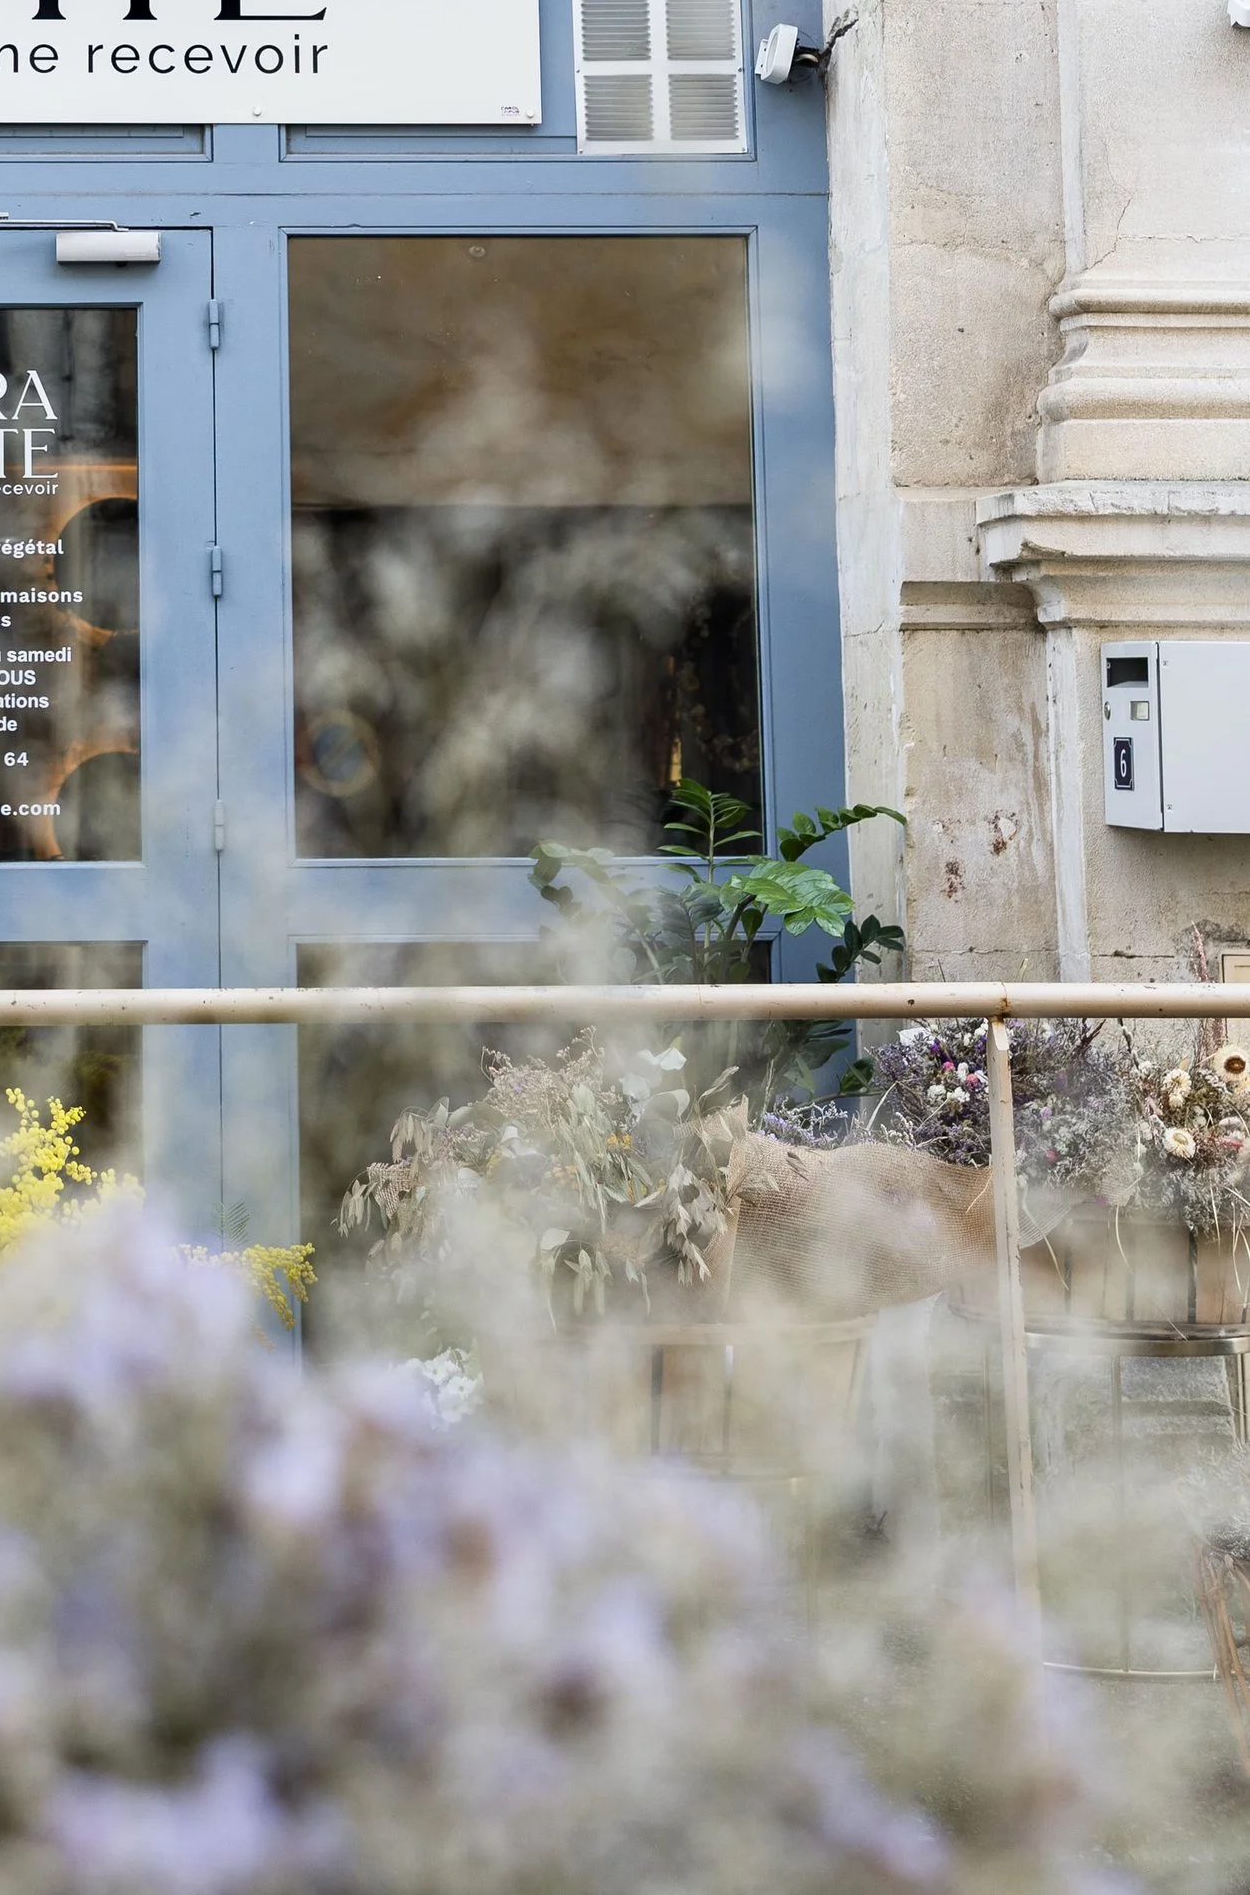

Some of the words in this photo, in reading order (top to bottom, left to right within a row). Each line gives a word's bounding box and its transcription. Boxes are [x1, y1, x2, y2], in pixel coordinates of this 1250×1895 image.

[88, 33, 329, 74] recevoir
[0, 587, 84, 604] maisons
[6, 646, 72, 664] samedi
[3, 751, 30, 768] 64
[1120, 749, 1127, 778] 6
